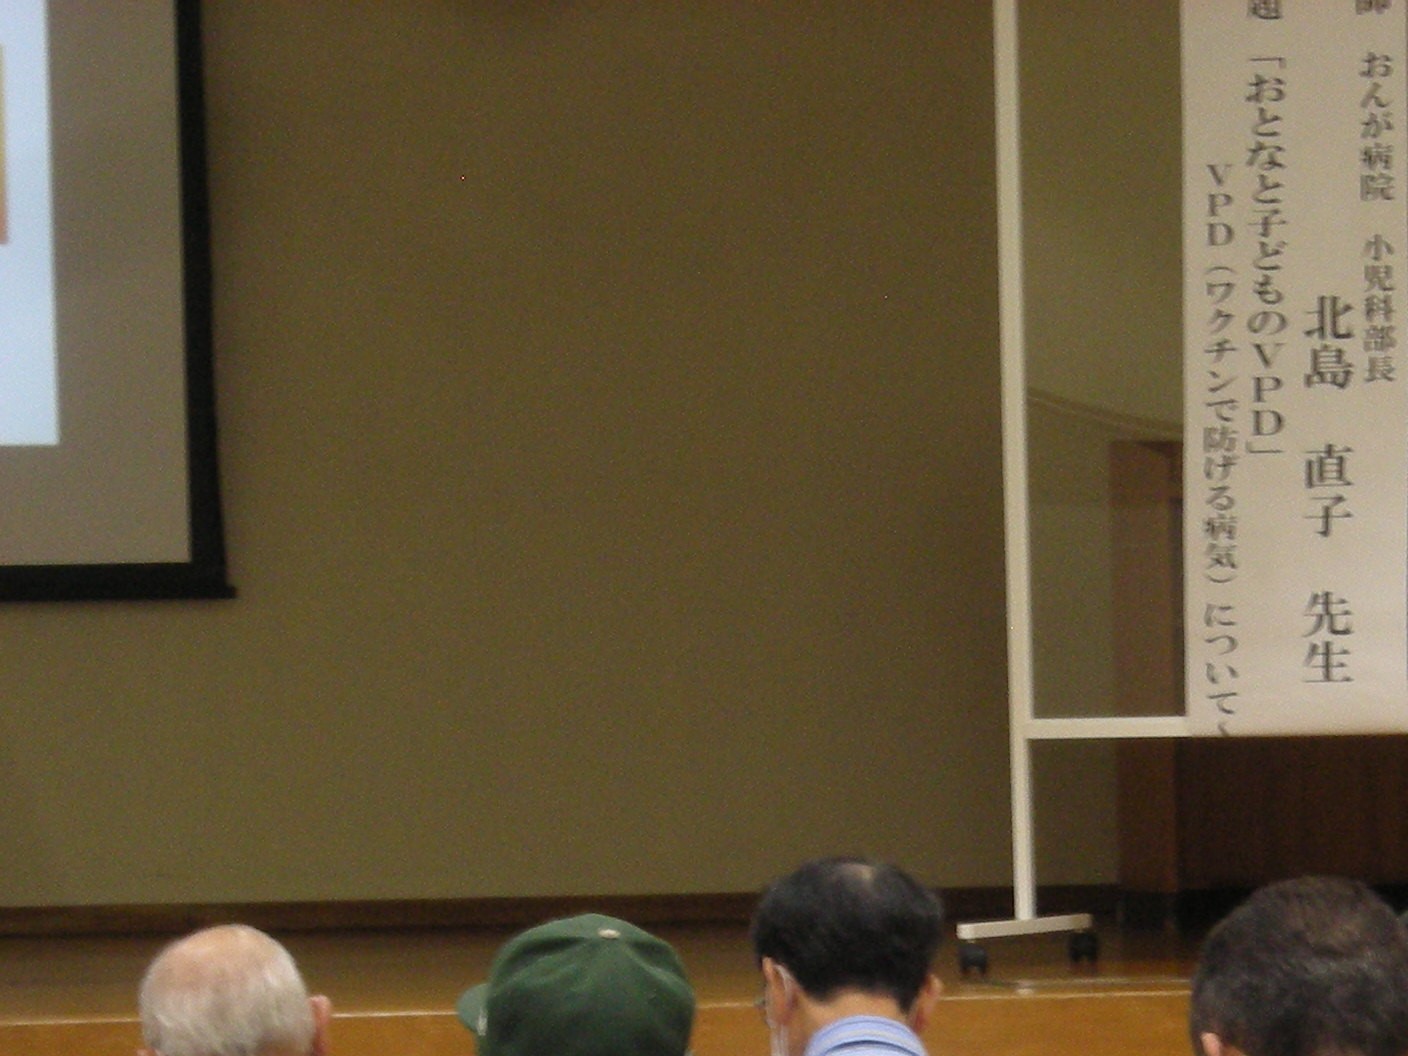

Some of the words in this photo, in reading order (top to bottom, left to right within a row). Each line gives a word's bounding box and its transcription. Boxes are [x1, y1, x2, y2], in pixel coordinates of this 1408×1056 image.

[1359, 52, 1395, 202] おんが病院
[1303, 294, 1355, 390] 北島
[1363, 234, 1396, 384] 小児科部長
[1303, 443, 1354, 538] 直子
[1302, 590, 1355, 684] 先生
